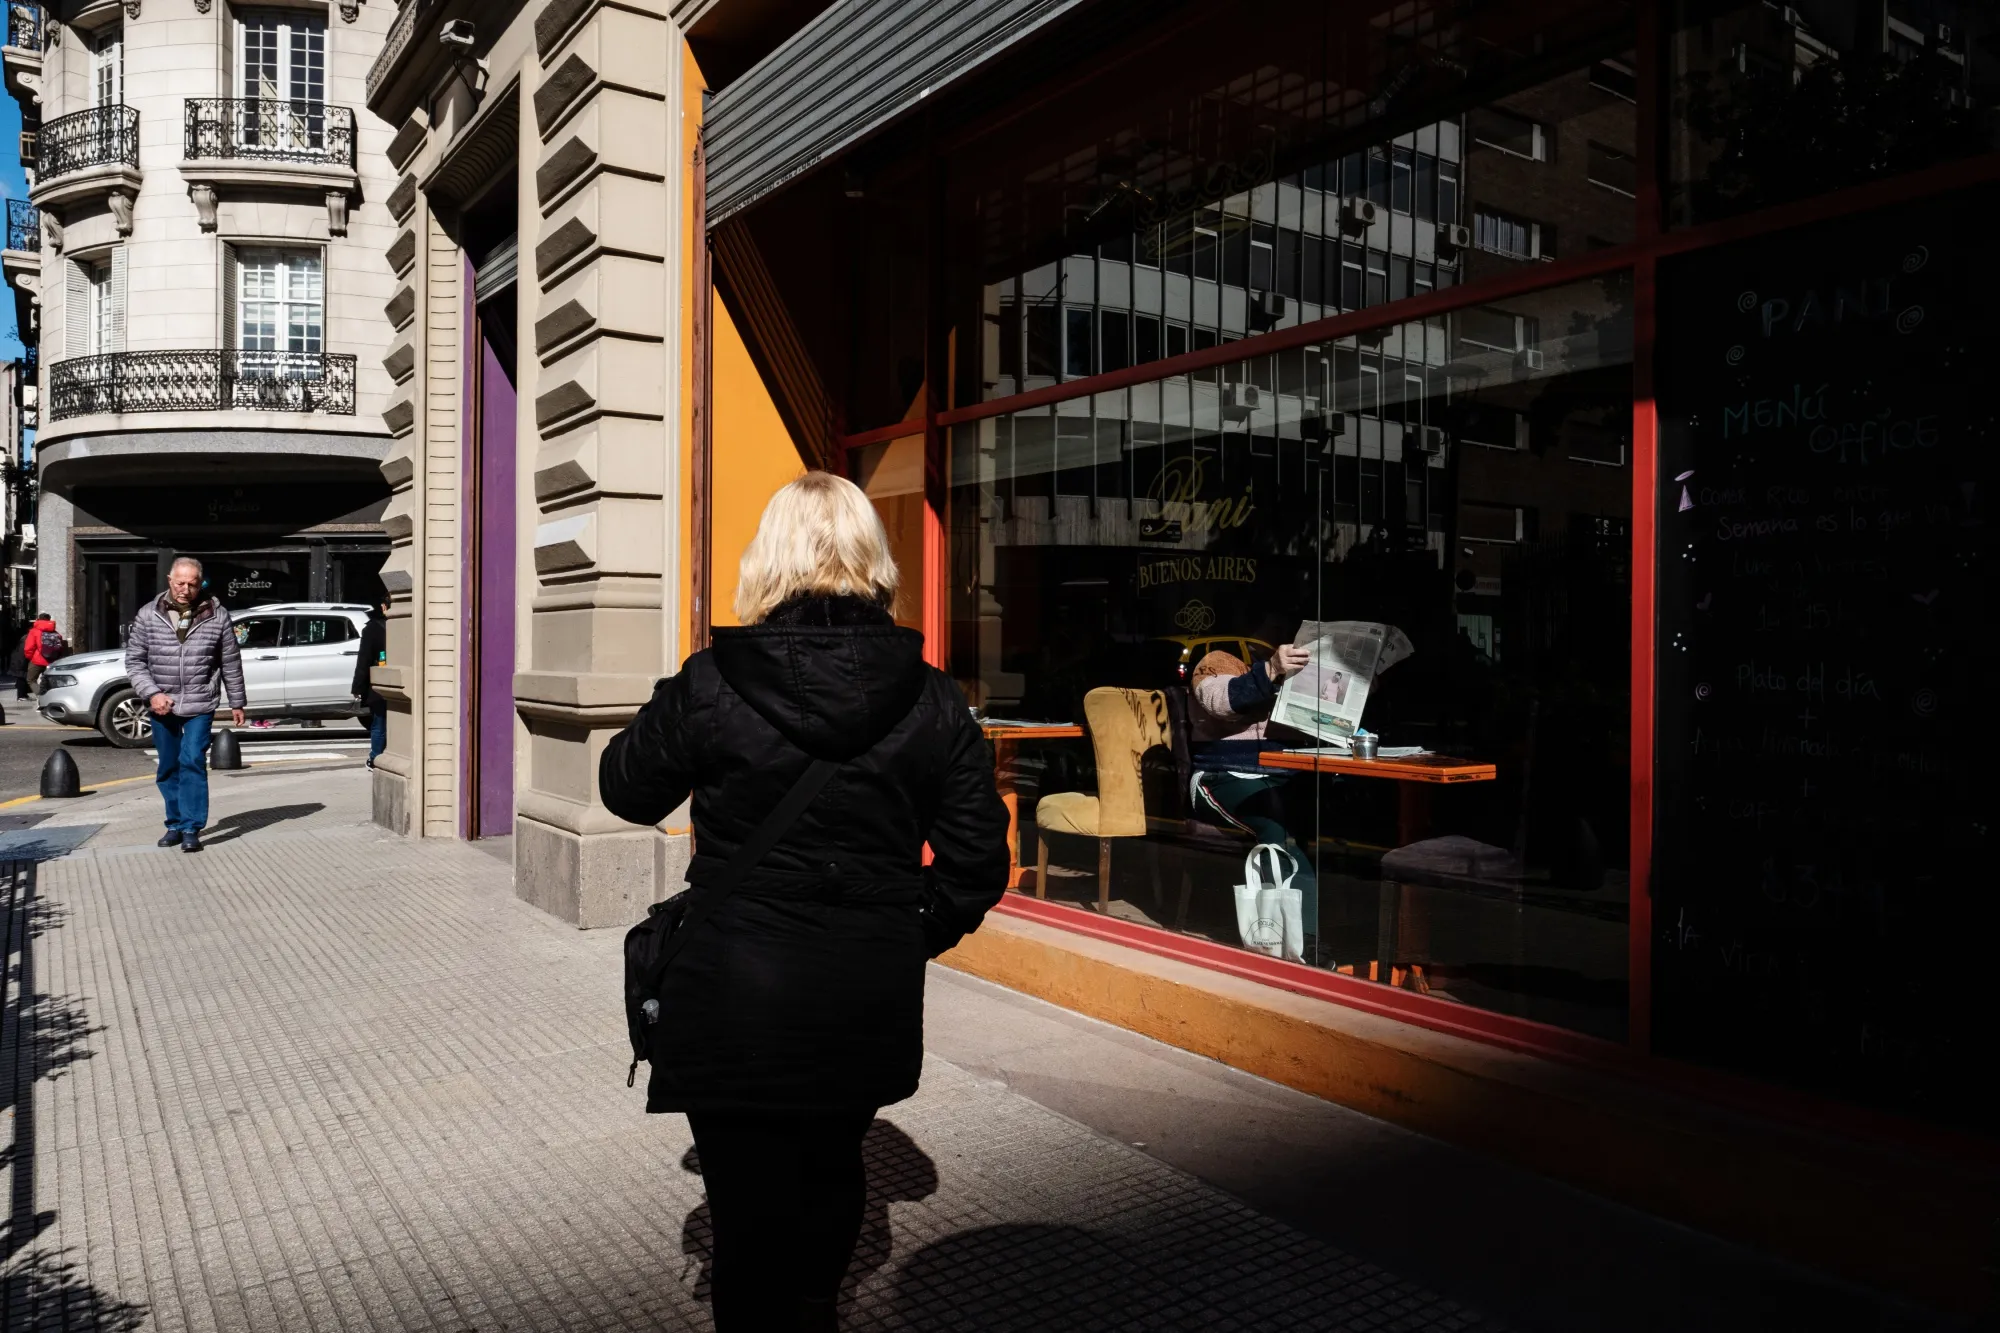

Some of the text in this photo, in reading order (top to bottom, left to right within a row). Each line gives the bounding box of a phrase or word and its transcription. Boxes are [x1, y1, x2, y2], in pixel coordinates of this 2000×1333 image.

[1760, 278, 1894, 339] PANI
[1141, 455, 1257, 536] Pani
[1815, 511, 1838, 534] es
[1850, 504, 1867, 533] lo
[227, 577, 273, 598] grabatto
[1140, 556, 1257, 589] BUENOS AIRES
[1735, 656, 1883, 704] Plato del día
